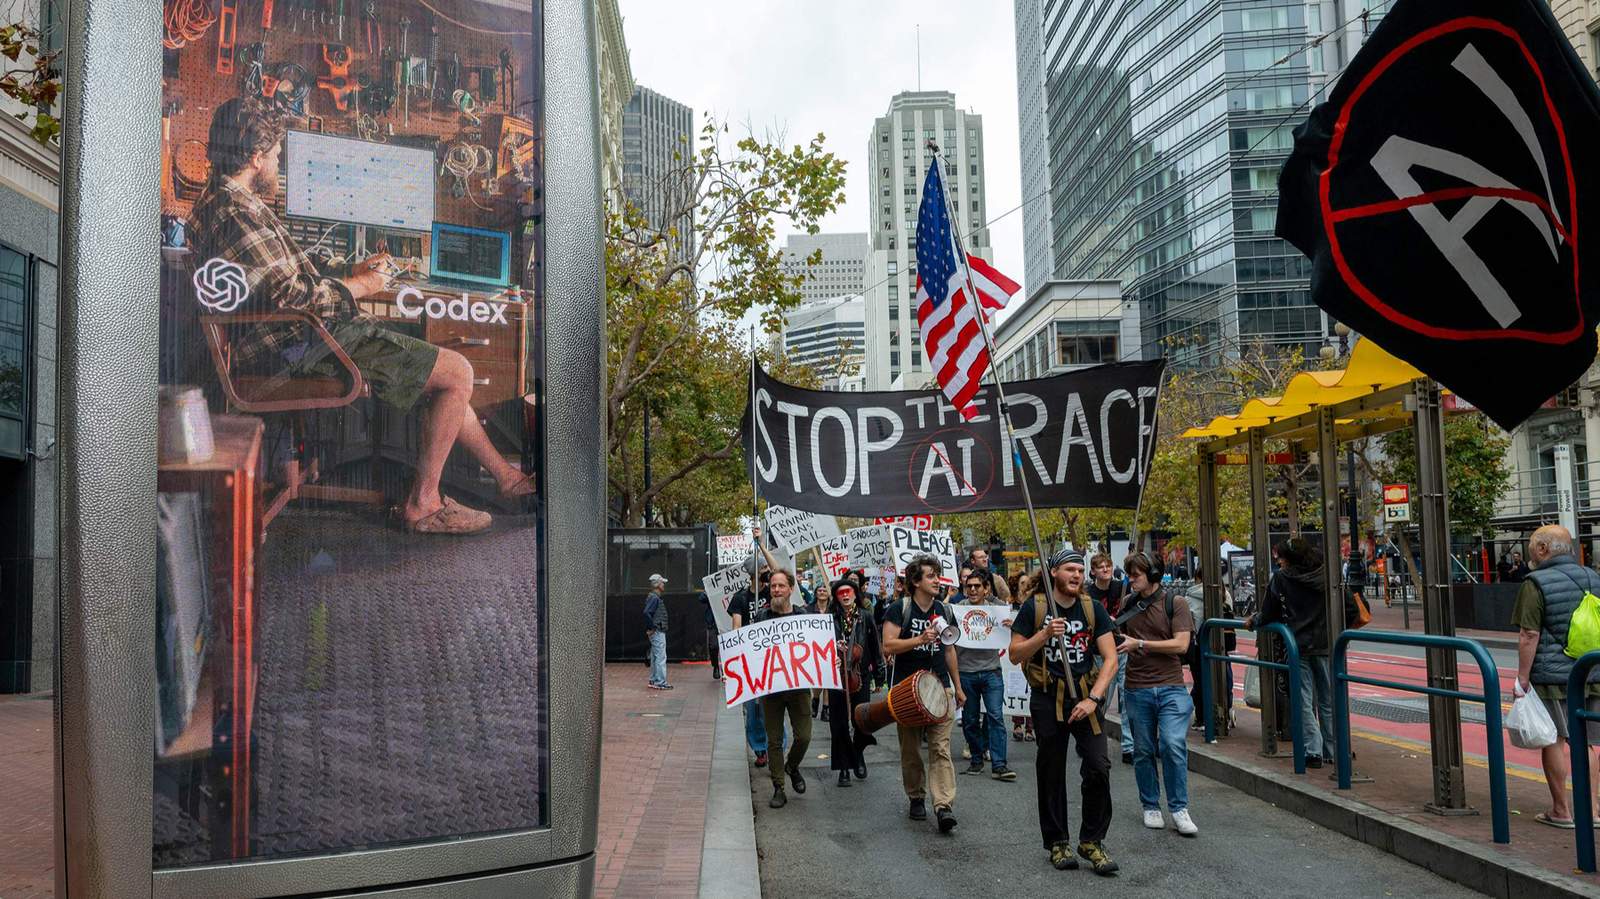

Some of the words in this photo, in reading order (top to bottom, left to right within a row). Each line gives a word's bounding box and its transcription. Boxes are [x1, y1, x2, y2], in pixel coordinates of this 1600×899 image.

[396, 287, 508, 324] Codex
[756, 388, 904, 497] STOP
[918, 438, 977, 499] AI
[769, 506, 793, 519] MA
[771, 511, 815, 532] TRAININ
[780, 522, 814, 539] RUNS
[789, 531, 826, 548] FAIL
[850, 528, 881, 540] ENOUGH
[822, 538, 840, 551] We
[853, 541, 891, 559] SATISF
[893, 527, 953, 556] PLEASE
[899, 552, 953, 577] SP
[710, 572, 722, 588] IF
[726, 568, 740, 582] NO
[720, 630, 745, 650] task
[747, 615, 833, 640] environment
[911, 618, 931, 630] STO
[753, 632, 805, 651] seems
[1044, 647, 1084, 663] RACE
[724, 639, 838, 704] SWARM
